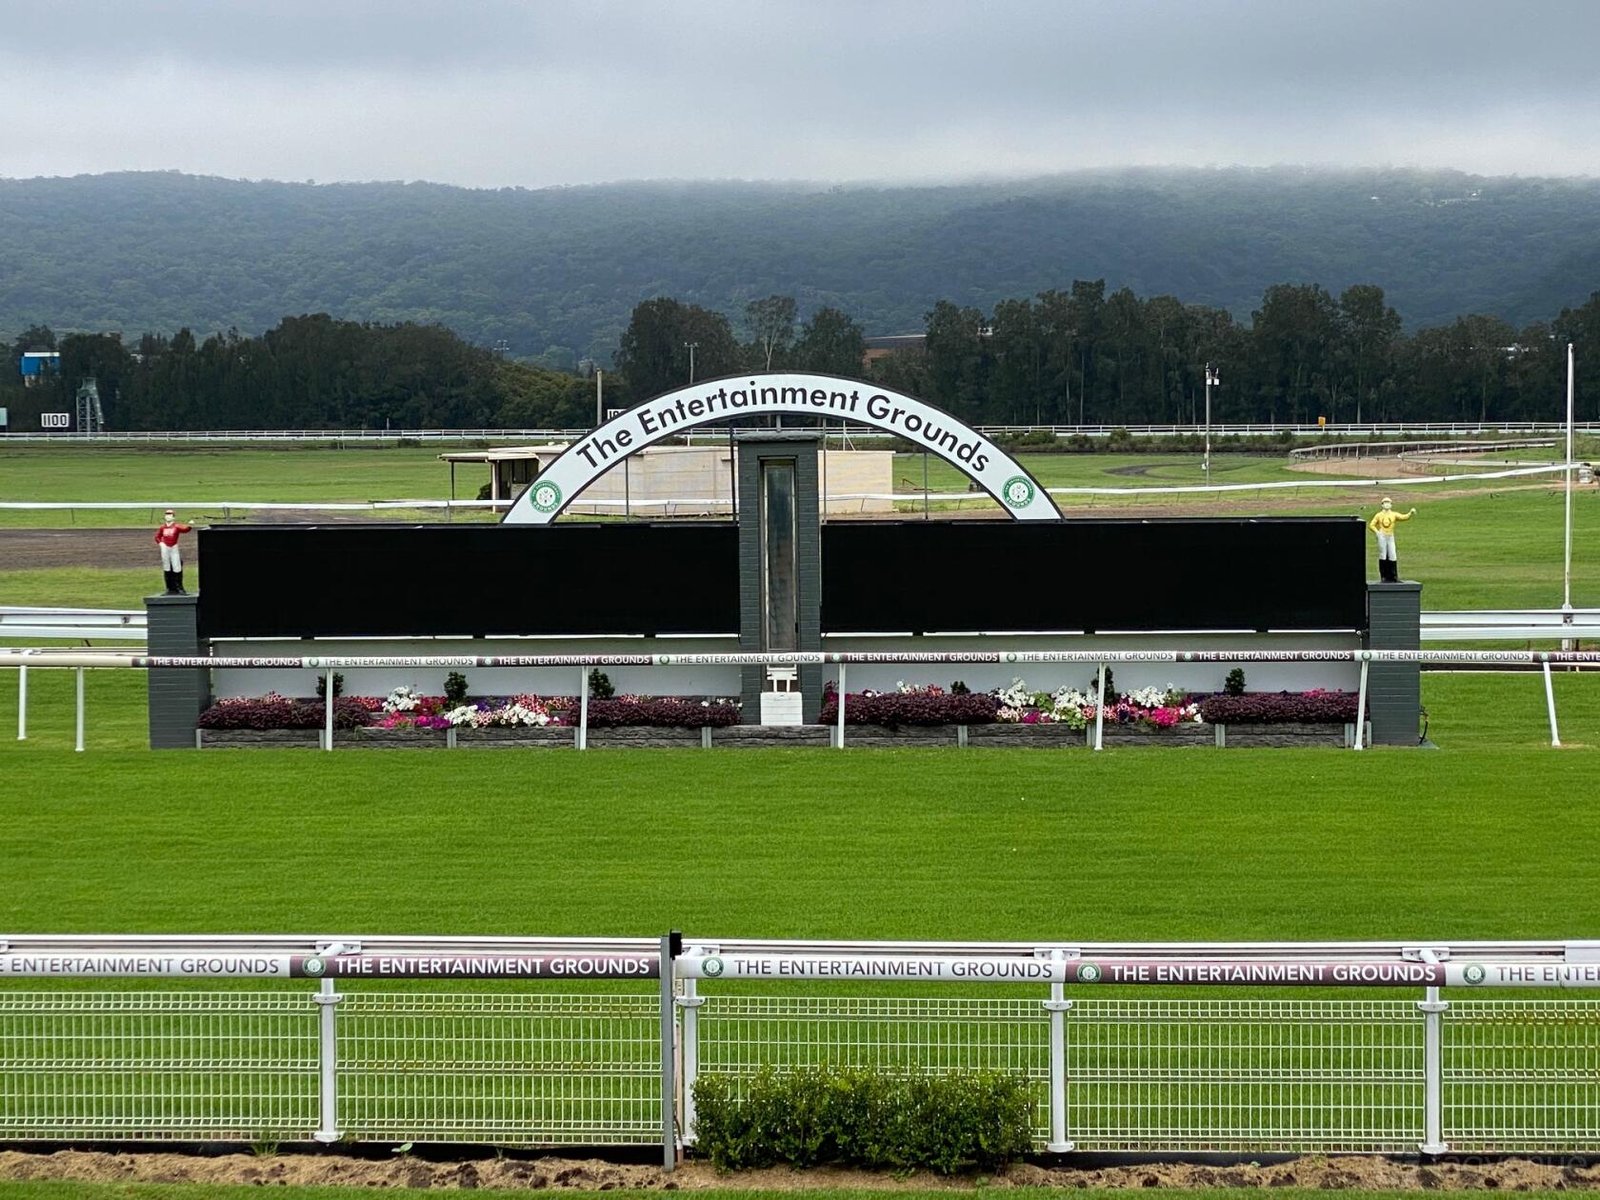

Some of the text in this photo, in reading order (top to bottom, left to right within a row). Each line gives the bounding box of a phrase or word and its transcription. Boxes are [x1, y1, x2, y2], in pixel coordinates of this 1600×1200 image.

[43, 414, 67, 426] 1100
[576, 381, 990, 473] The Entertainment Grounds
[498, 656, 650, 666] THE ENTERTAINMENT GROUNDS
[675, 655, 694, 664] THE
[695, 655, 776, 664] ENTERTAINMENT
[846, 653, 998, 662] THE ENTERTAINMENT GROUNDS
[1022, 652, 1173, 662] THE ENTERTAINMENT GROUNDS
[1198, 652, 1351, 661] THE ENTERTAINMENT GROUNDS
[1377, 652, 1530, 661] THE ENTERTAINMENT GROUNDS
[1556, 652, 1574, 661] THE
[151, 657, 300, 667] THE ENTERTAINMENT GROUNDS
[324, 657, 473, 667] THE ENTERTAINMENT GROUNDS
[11, 958, 174, 973] ENTERTAINMENT
[181, 958, 279, 974] GROUNDS
[336, 959, 374, 975] THE
[379, 958, 544, 975] ENTERTAINMENT
[550, 958, 650, 975] GROUNDS
[734, 960, 772, 975] THE
[779, 960, 945, 976] ENTERTAINMENT
[951, 962, 1053, 979] GROUNDS
[1111, 965, 1149, 981] THE
[1157, 965, 1327, 981] ENTERTAINMENT
[1333, 964, 1436, 982] GROUNDS
[1496, 966, 1535, 981] THE
[1543, 966, 1600, 982] ENTE
